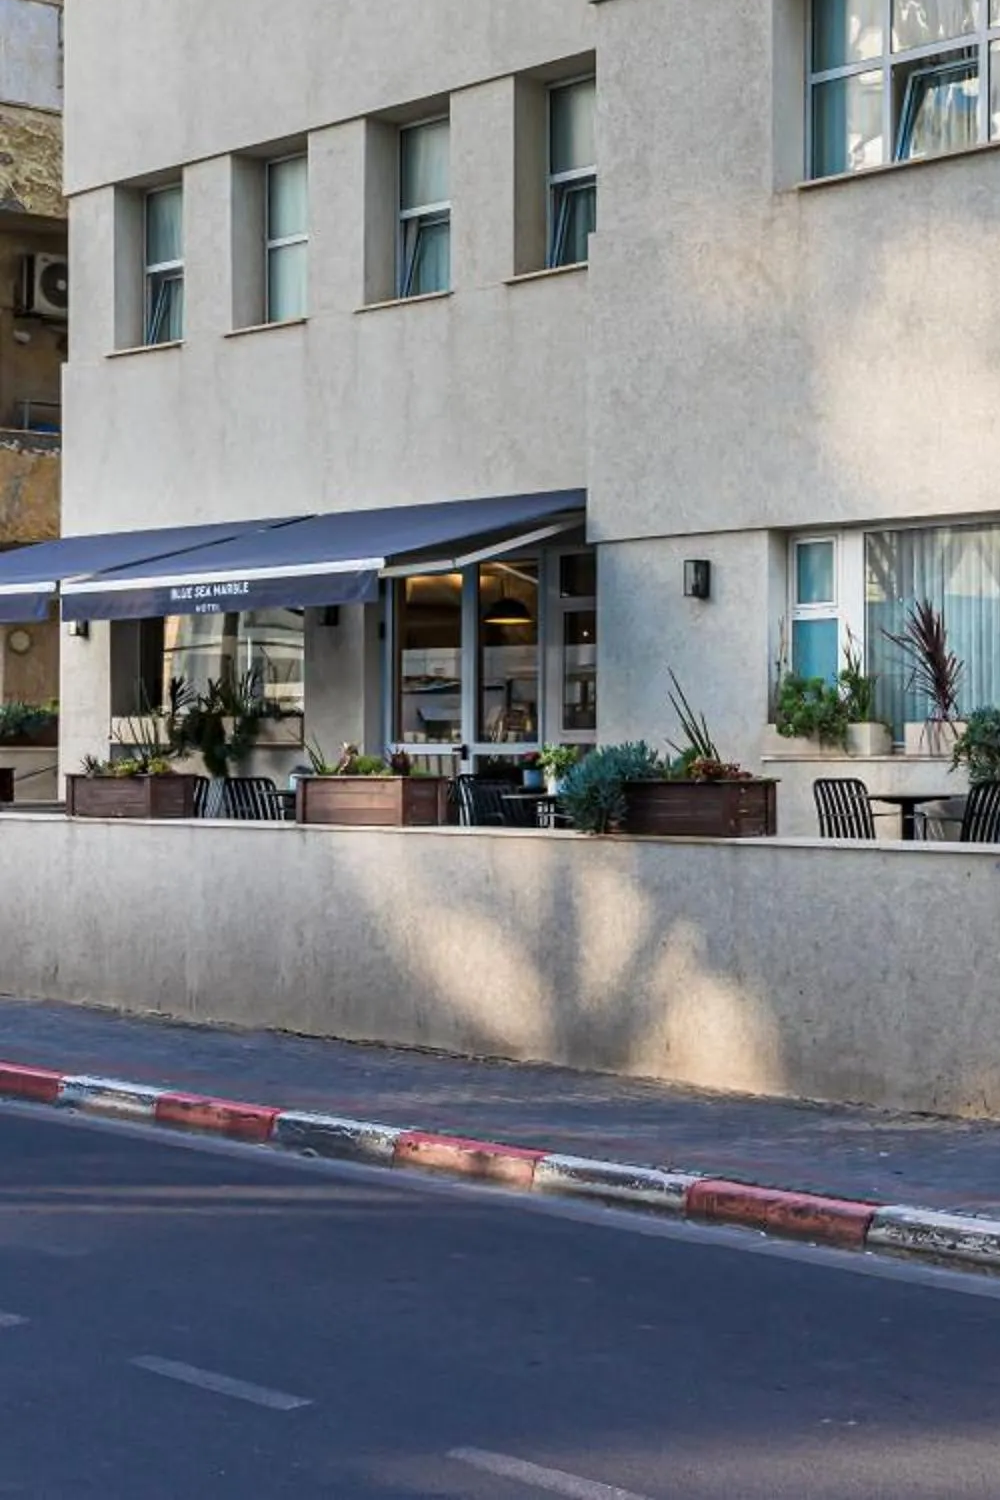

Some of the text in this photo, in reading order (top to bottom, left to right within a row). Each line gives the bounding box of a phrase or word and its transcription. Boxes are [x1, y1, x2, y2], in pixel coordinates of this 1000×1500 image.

[171, 582, 249, 600] BLUE SEA MARBLE
